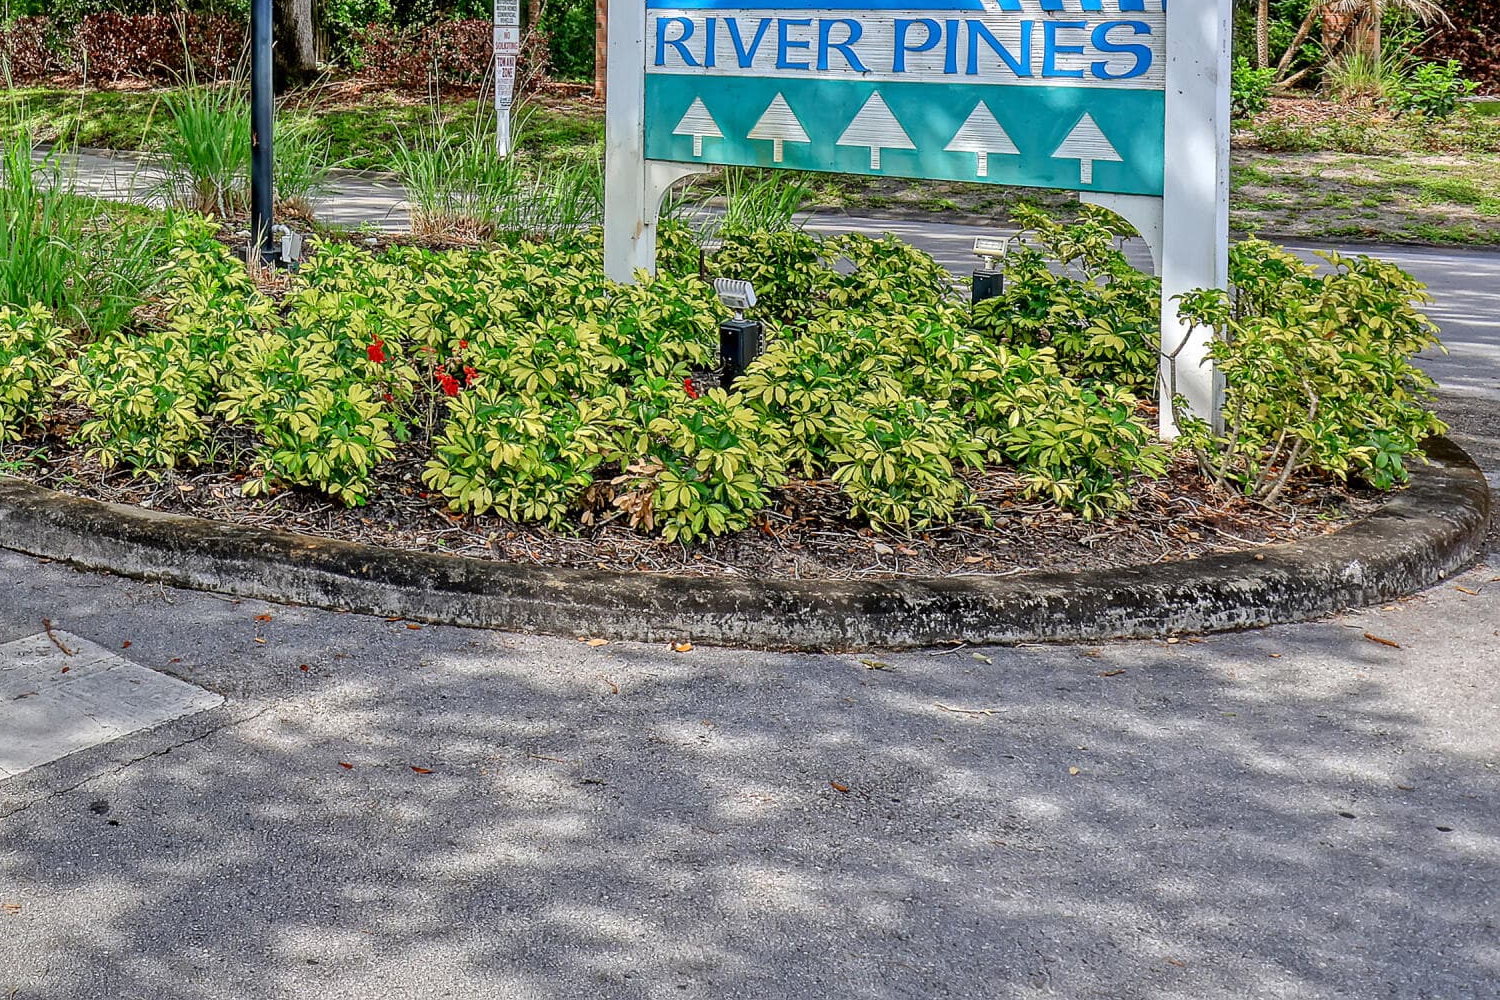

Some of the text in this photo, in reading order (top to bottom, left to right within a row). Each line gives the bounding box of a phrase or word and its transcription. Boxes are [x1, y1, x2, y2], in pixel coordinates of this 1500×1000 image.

[504, 31, 511, 39] NO
[495, 41, 518, 50] SOLICITING
[655, 17, 1154, 81] RIVER PINES
